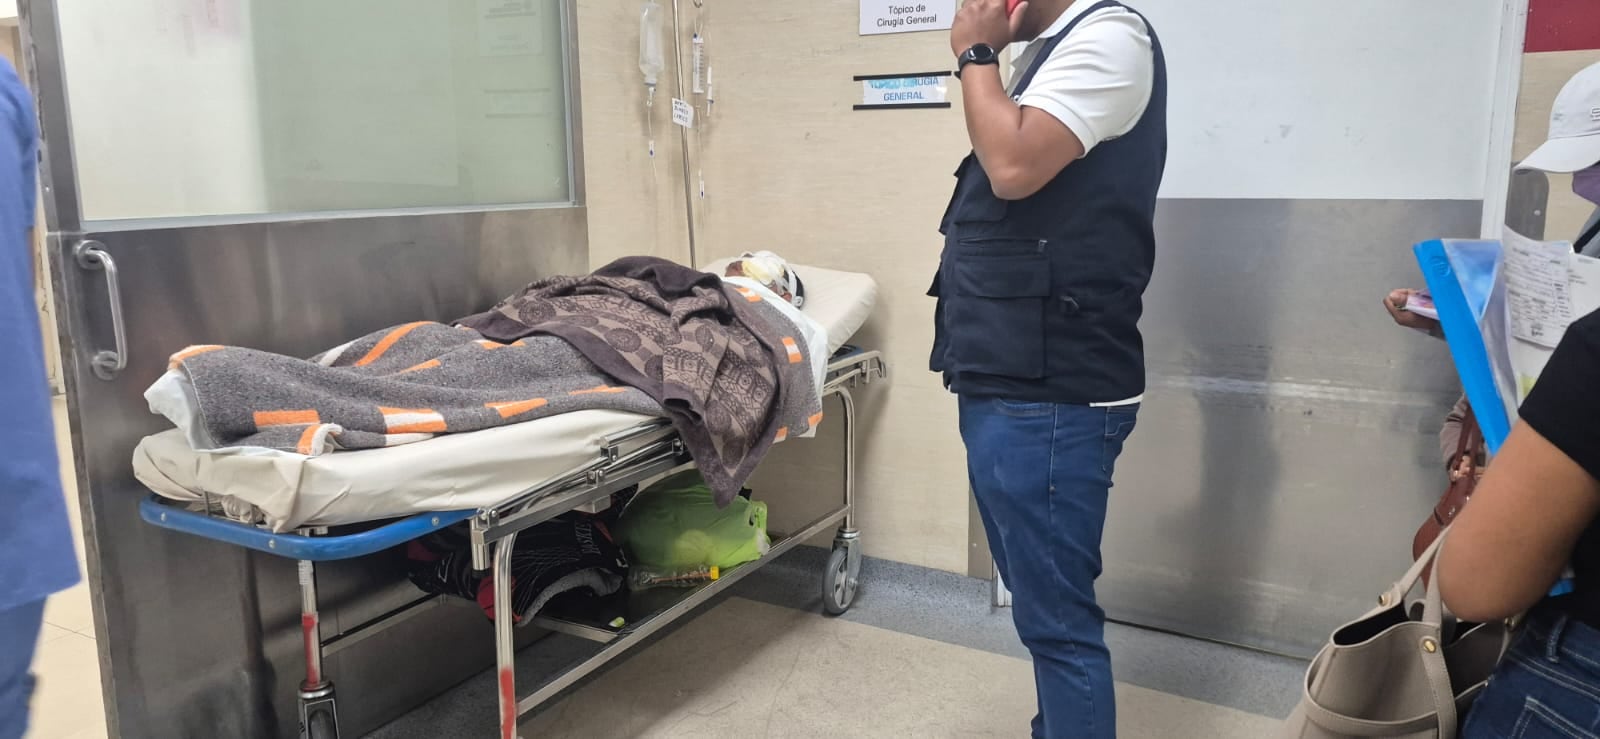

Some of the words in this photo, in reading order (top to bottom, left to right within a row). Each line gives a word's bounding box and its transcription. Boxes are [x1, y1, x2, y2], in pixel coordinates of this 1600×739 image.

[888, 5, 914, 16] Tópico
[915, 3, 926, 12] de
[906, 13, 937, 25] General
[883, 91, 925, 101] GENERAL
